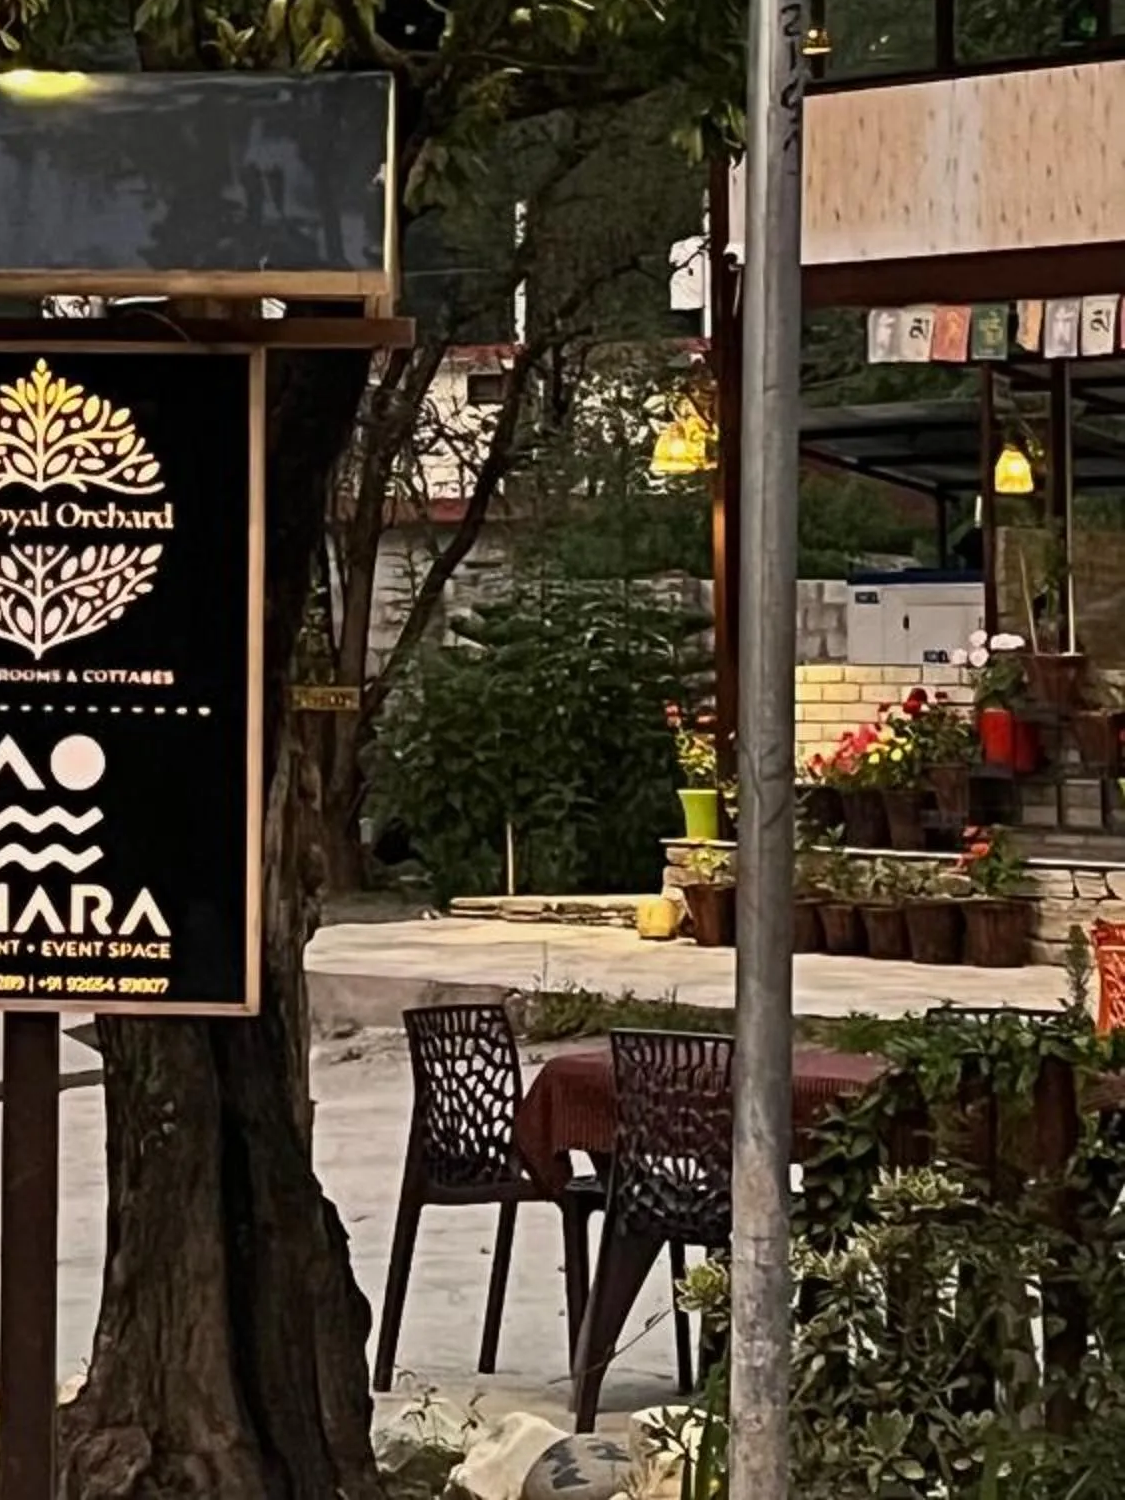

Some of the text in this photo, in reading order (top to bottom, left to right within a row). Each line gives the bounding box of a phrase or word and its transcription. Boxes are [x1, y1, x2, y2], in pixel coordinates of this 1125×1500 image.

[55, 502, 175, 530] Orchard
[66, 669, 78, 683] &
[82, 669, 175, 686] COTTAGES
[40, 940, 104, 958] EVENT
[107, 941, 171, 960] SPACE
